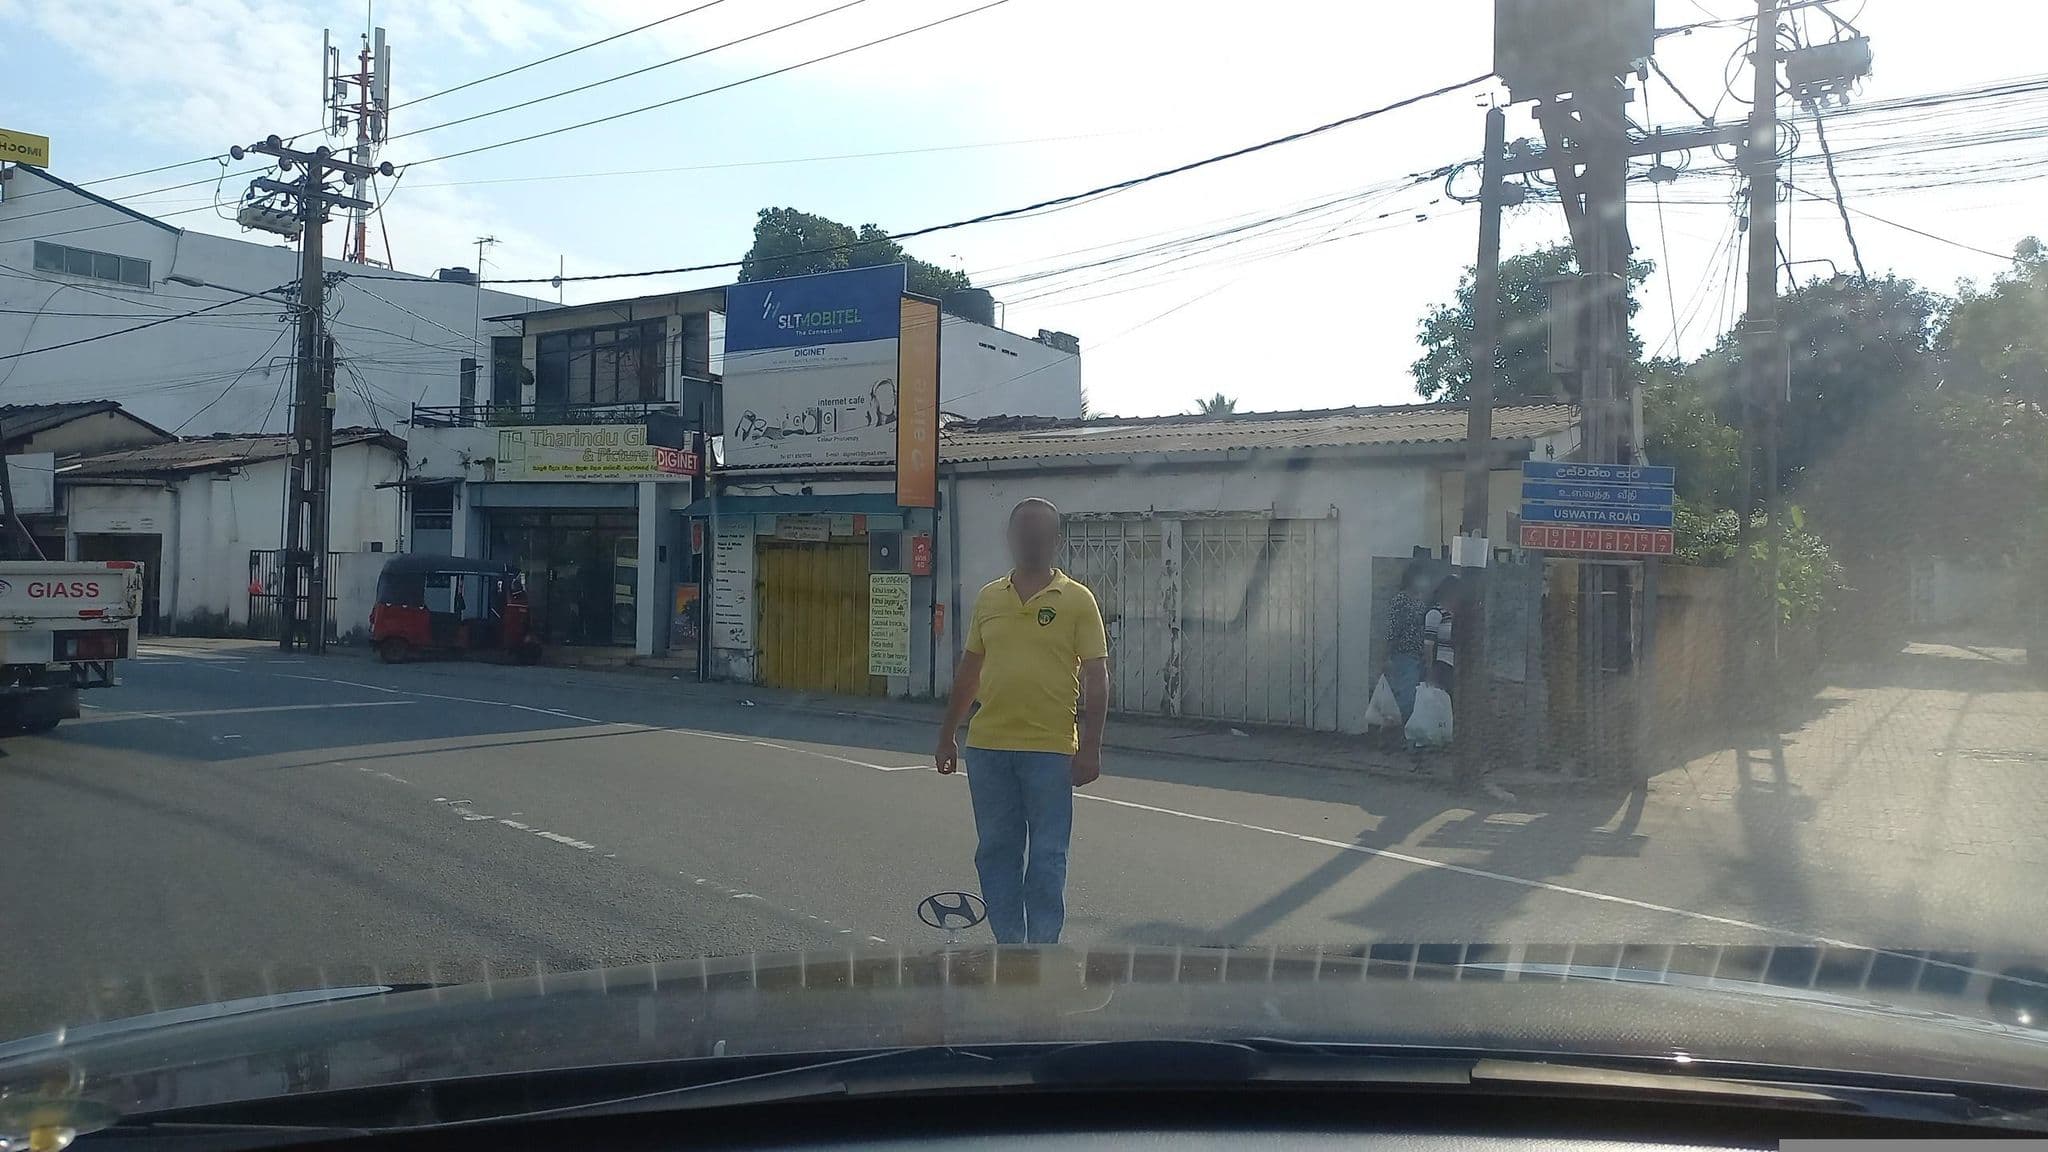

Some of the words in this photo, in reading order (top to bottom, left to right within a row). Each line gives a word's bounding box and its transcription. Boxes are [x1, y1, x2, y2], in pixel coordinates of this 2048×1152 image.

[794, 348, 826, 357] DIGINET
[817, 397, 847, 406] internet
[531, 429, 618, 447] Tharindu
[623, 428, 647, 446] Gl
[583, 448, 594, 462] &
[598, 448, 648, 462] Picture
[657, 451, 698, 470] DIGINET
[1553, 509, 1607, 520] USWATTA
[1608, 512, 1641, 522] ROAD
